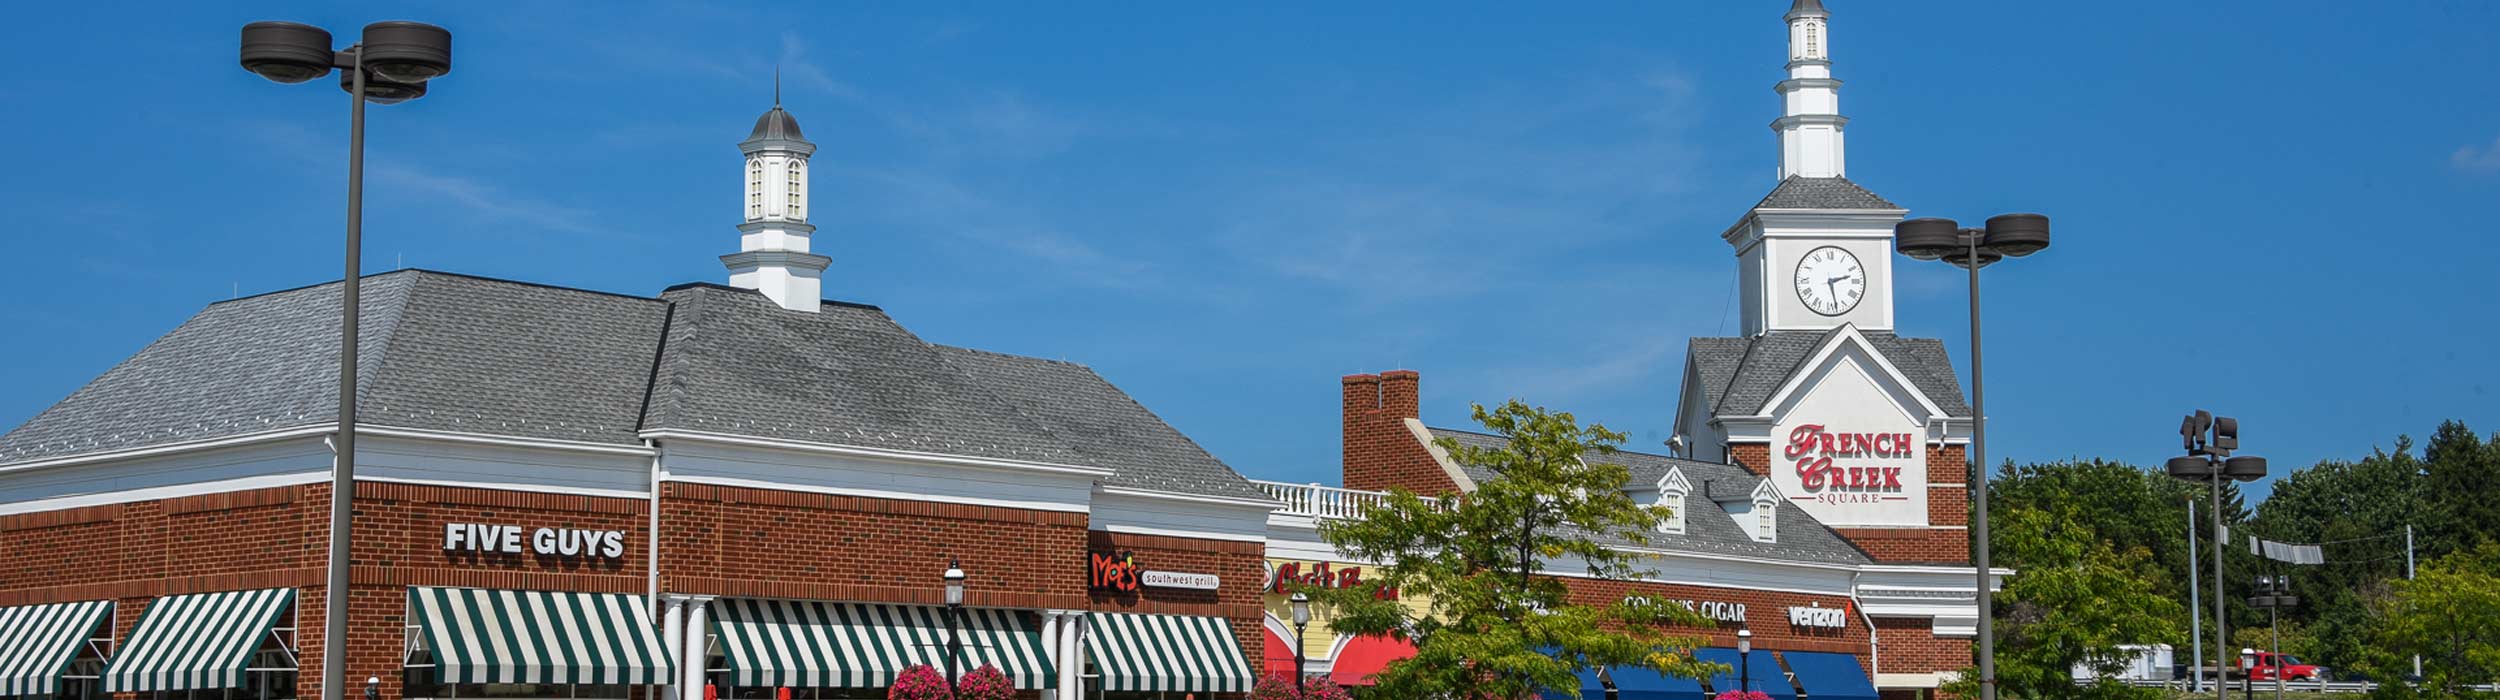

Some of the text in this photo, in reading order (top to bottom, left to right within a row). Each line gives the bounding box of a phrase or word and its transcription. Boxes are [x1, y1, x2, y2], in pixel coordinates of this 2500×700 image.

[1785, 424, 1912, 458] FRENCH
[1796, 456, 1902, 492] CREEK
[1818, 493, 1879, 505] SQUARE
[445, 523, 624, 558] FIVE GUYS
[1146, 574, 1214, 587] southwest grill
[1701, 601, 1746, 621] CIGAR
[1789, 601, 1846, 627] verizon
